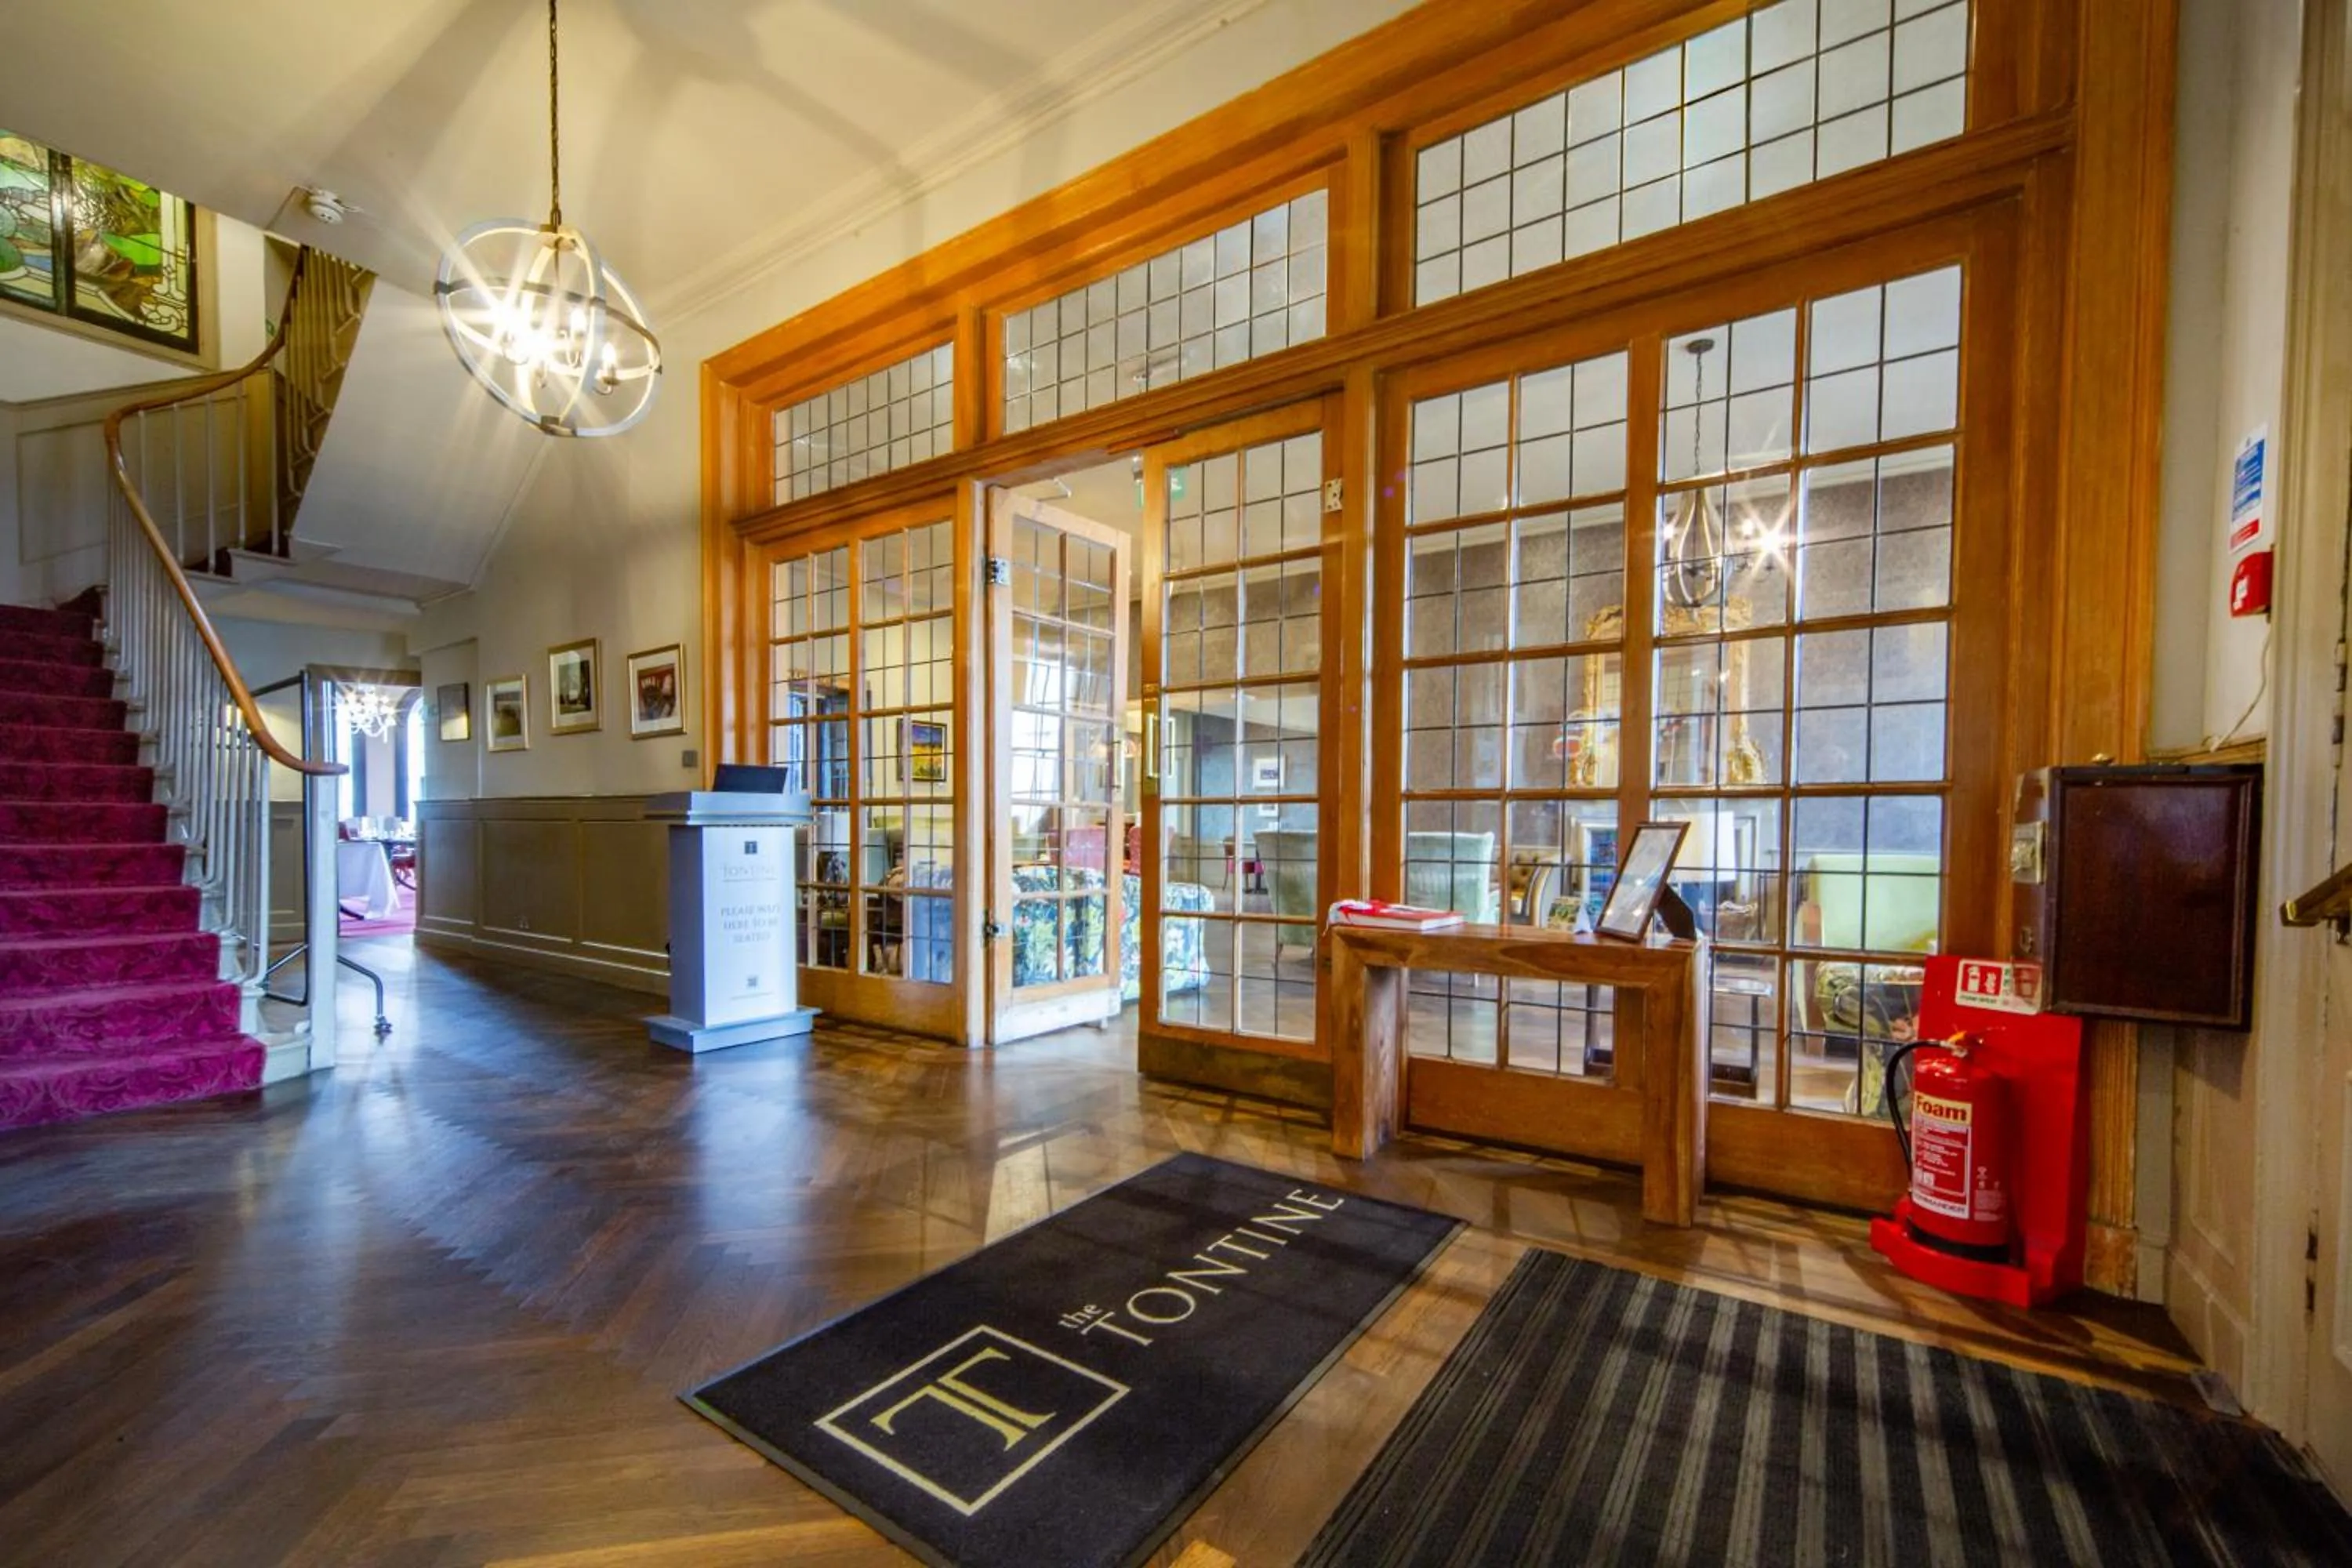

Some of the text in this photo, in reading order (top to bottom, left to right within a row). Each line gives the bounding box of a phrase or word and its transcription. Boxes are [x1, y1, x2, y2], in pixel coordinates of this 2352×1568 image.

[720, 903, 780, 916] PLEASE WAIT
[723, 919, 749, 931] HERE
[1916, 1095, 1966, 1121] Foam
[1058, 1189, 1345, 1347] the TONTINE
